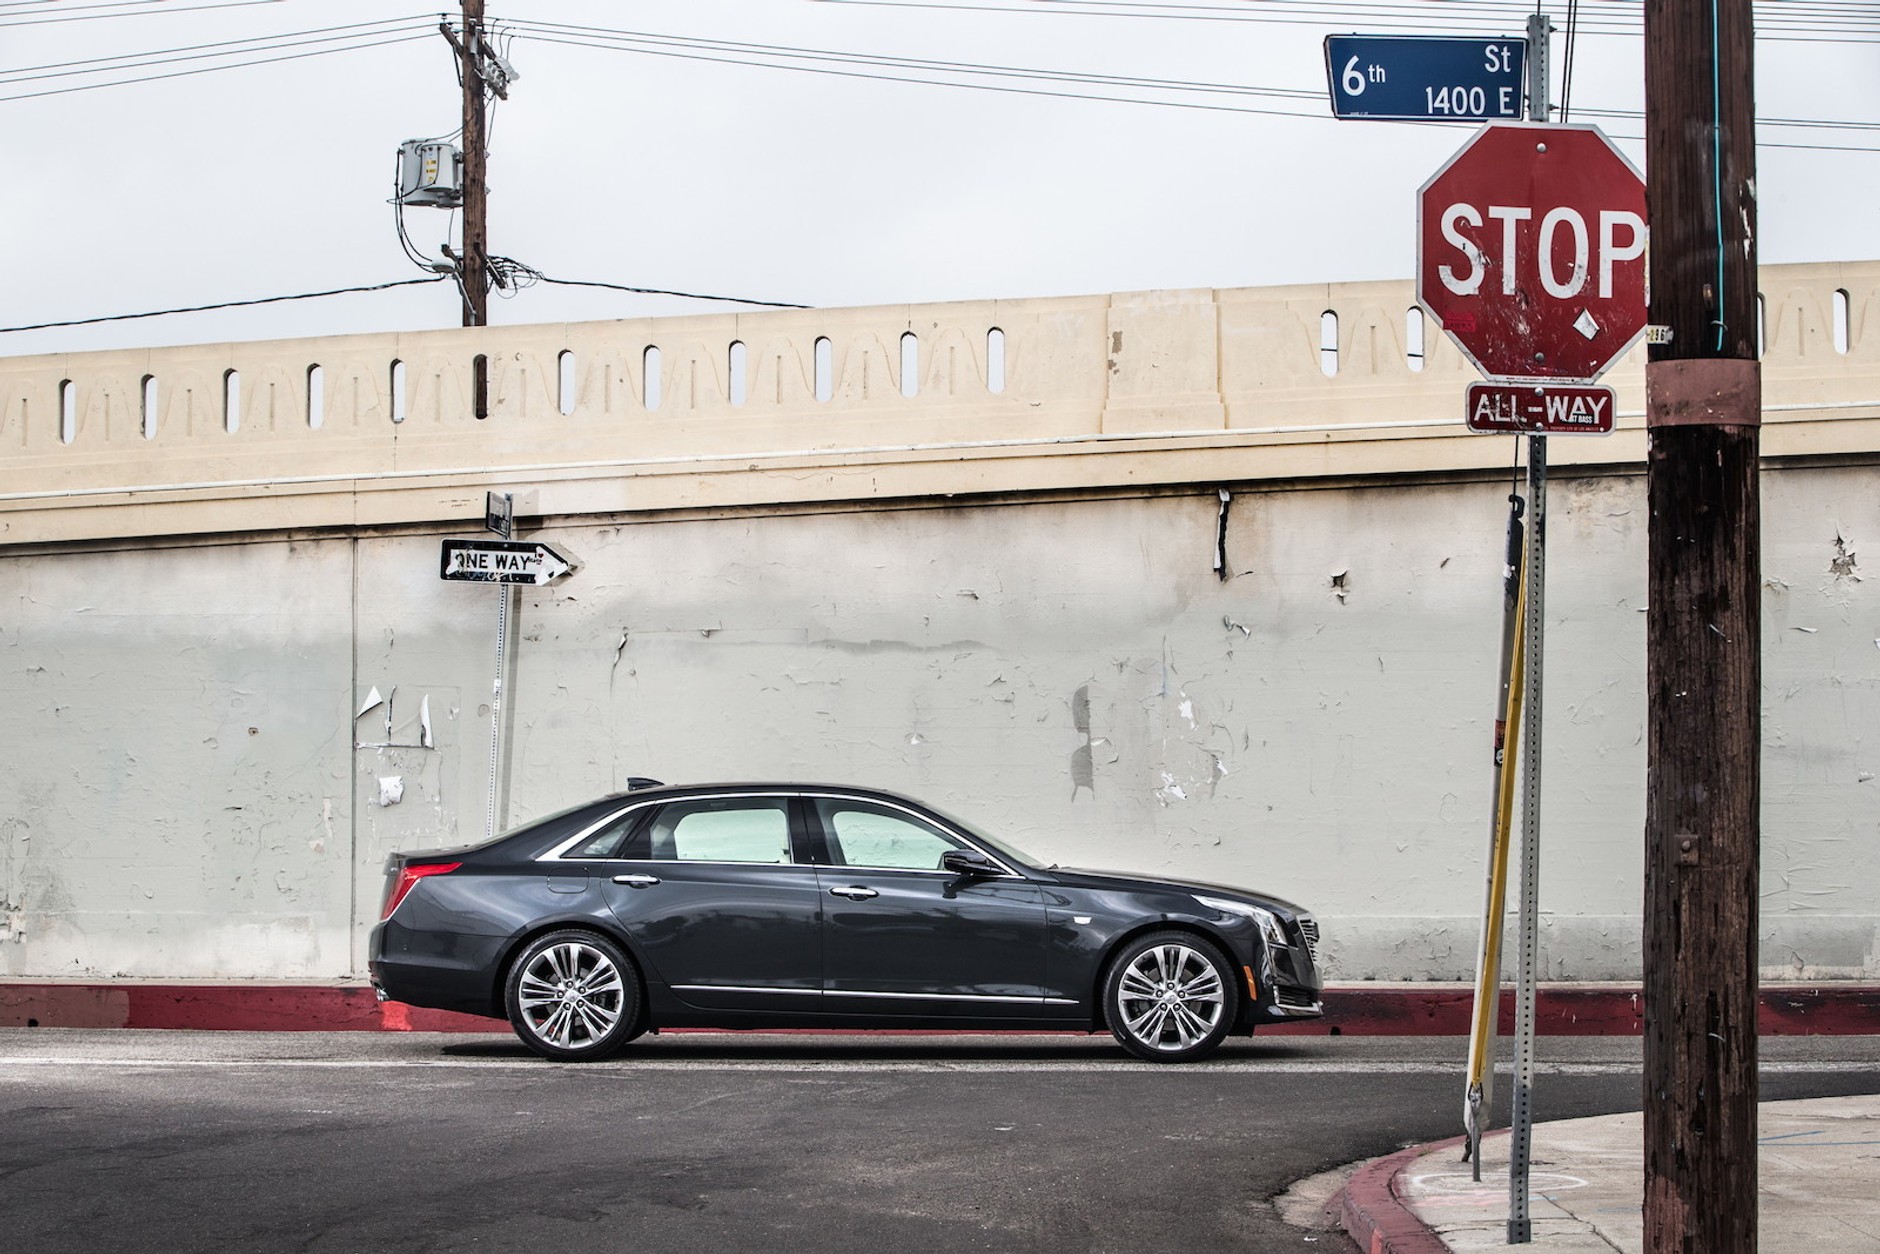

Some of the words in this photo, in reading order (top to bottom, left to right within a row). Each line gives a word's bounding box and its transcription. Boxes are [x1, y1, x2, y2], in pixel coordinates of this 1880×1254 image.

[1342, 55, 1386, 97] 6th
[1484, 44, 1512, 73] St
[1425, 86, 1486, 116] 1400
[1498, 87, 1515, 115] E
[1438, 202, 1646, 299] STOP
[1473, 393, 1608, 424] ALL-WAY
[495, 553, 529, 571] WAY
